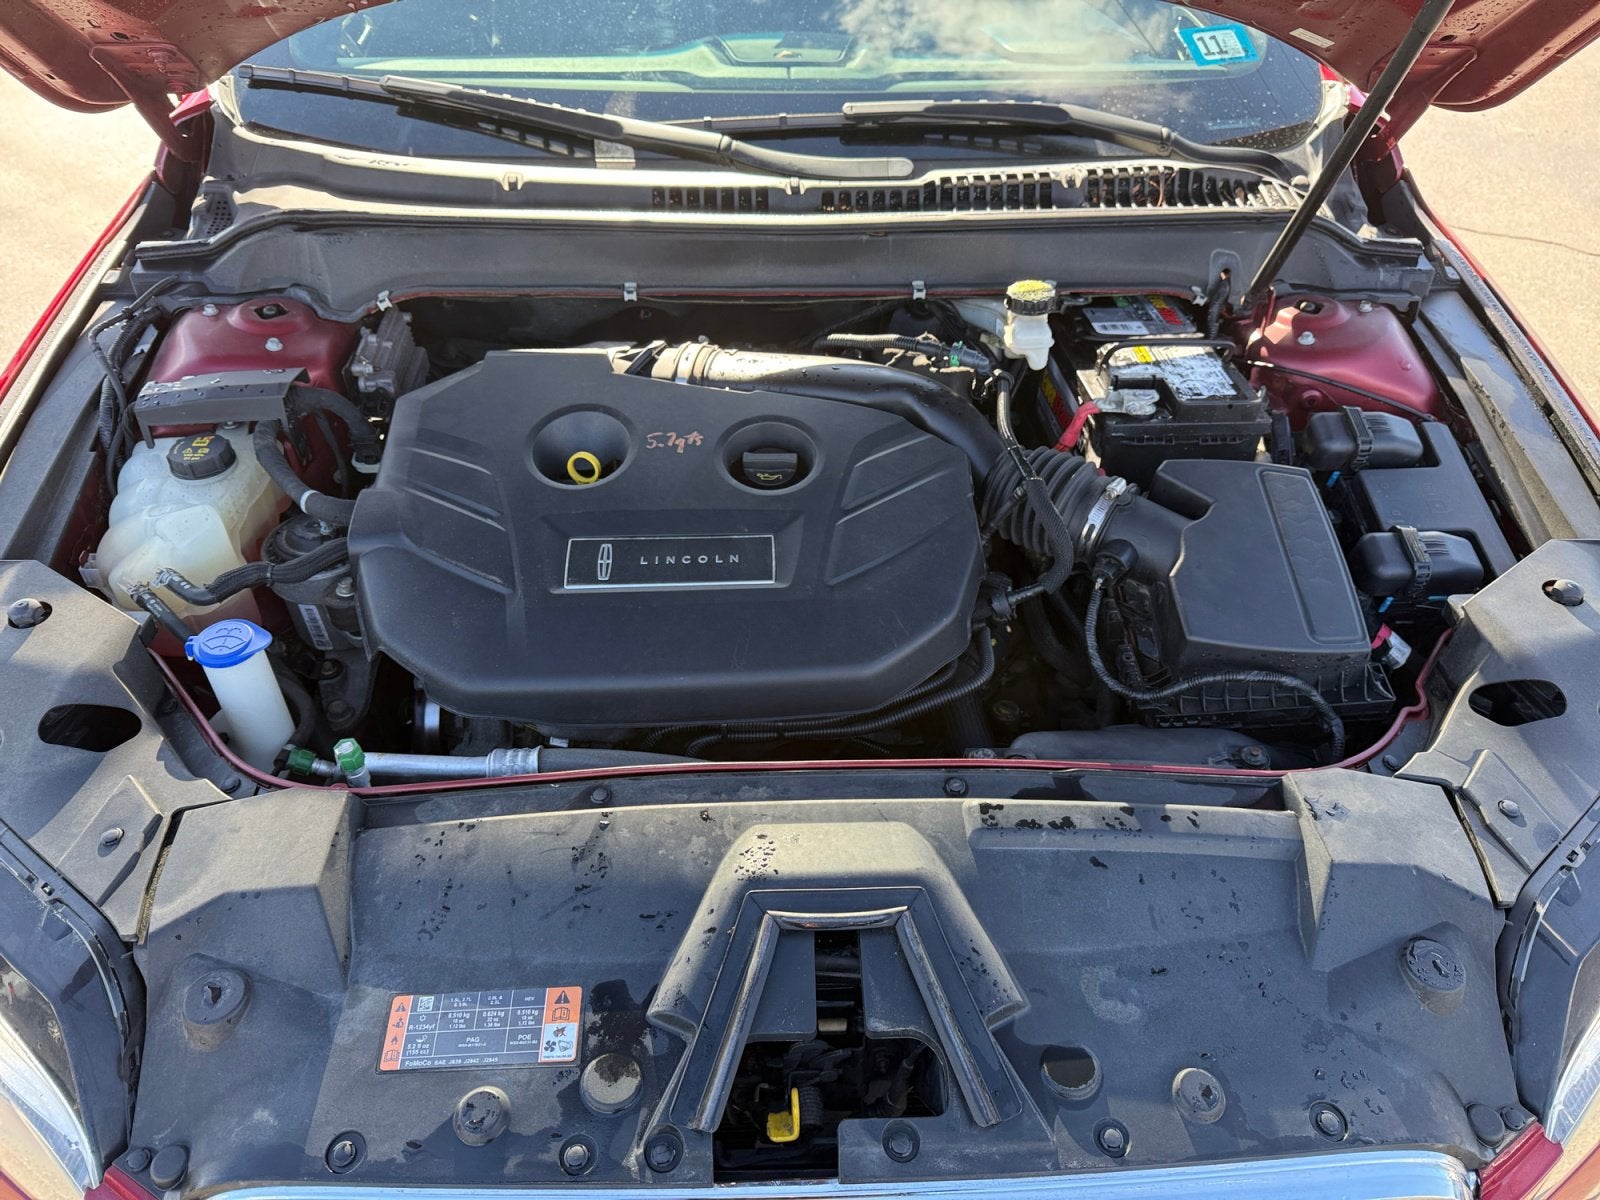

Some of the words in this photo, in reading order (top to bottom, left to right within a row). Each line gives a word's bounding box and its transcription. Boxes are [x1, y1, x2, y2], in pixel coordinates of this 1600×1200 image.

[1196, 35, 1228, 57] 11
[640, 554, 740, 565] LINCOLN
[497, 1010, 505, 1018] kg
[408, 1023, 436, 1031] R-1234yf
